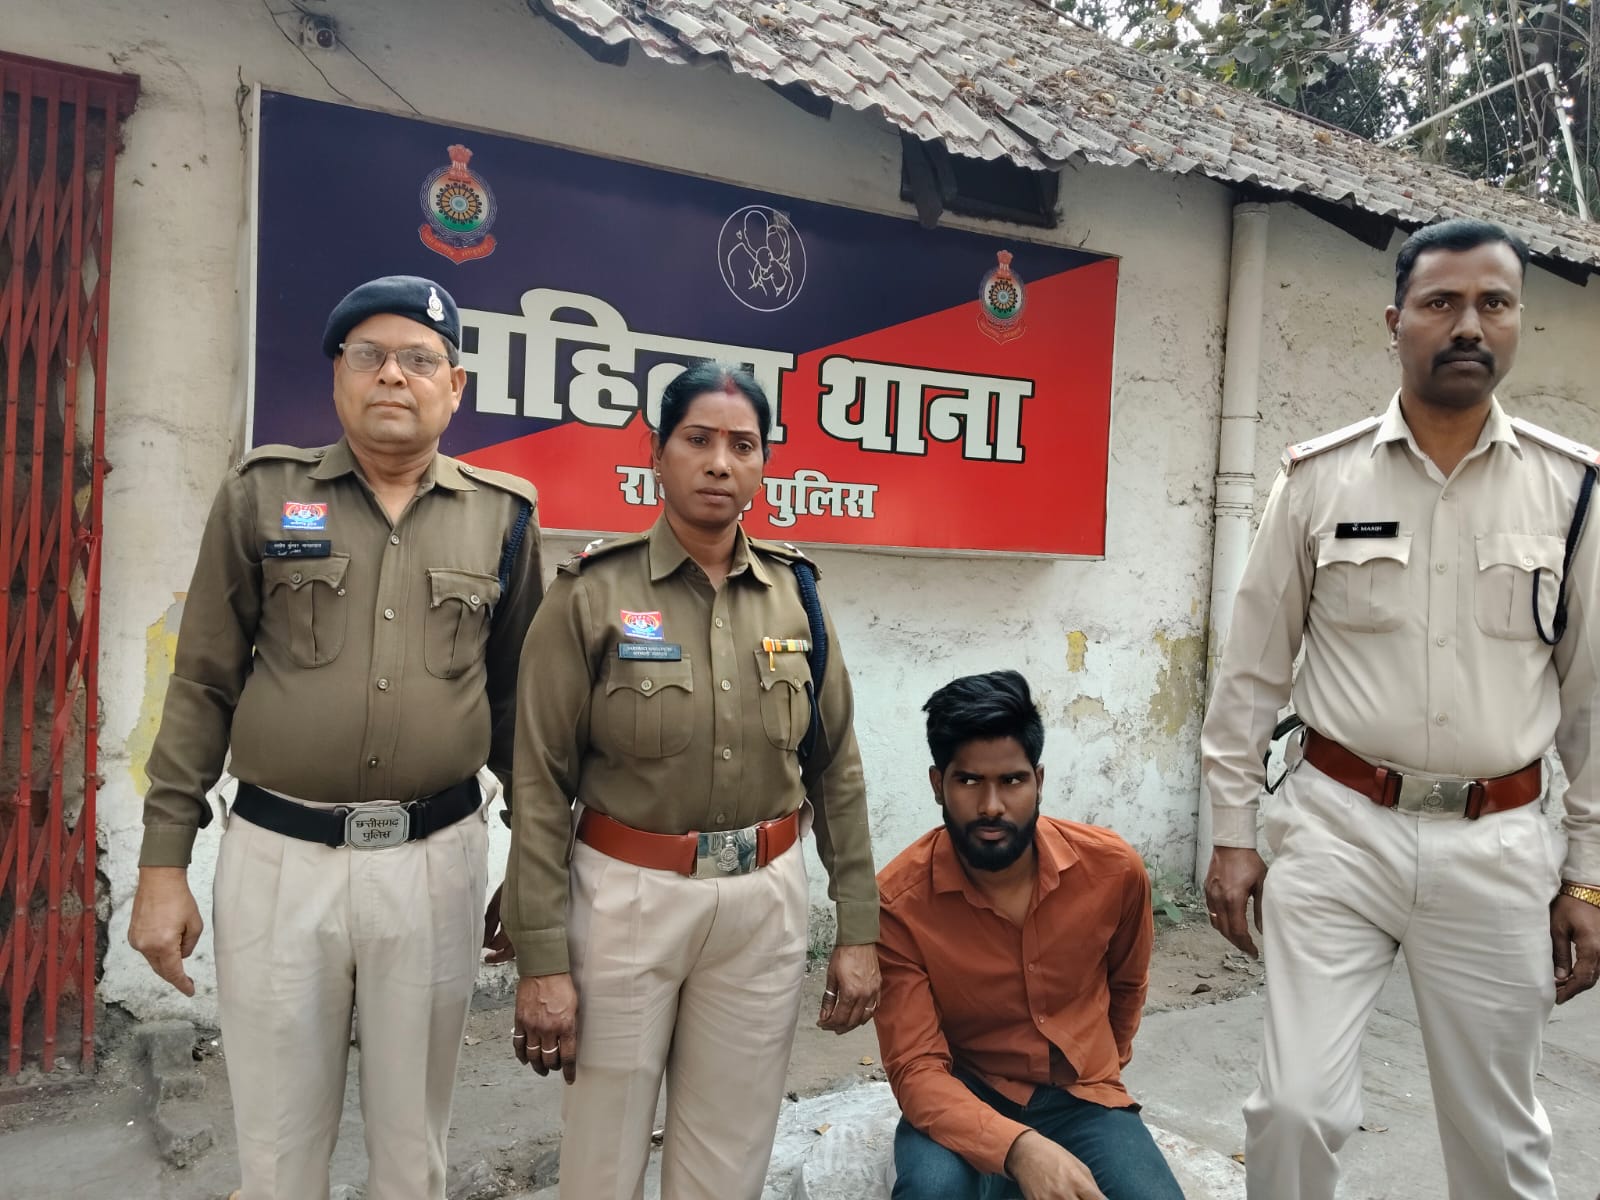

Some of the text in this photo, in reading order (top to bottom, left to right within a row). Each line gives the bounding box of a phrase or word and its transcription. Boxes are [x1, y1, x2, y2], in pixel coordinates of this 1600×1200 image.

[818, 354, 1035, 463] थाना
[762, 469, 879, 527] पुलिस
[355, 817, 400, 828] छत्तीसगढ़
[362, 829, 392, 842] पुलिस
